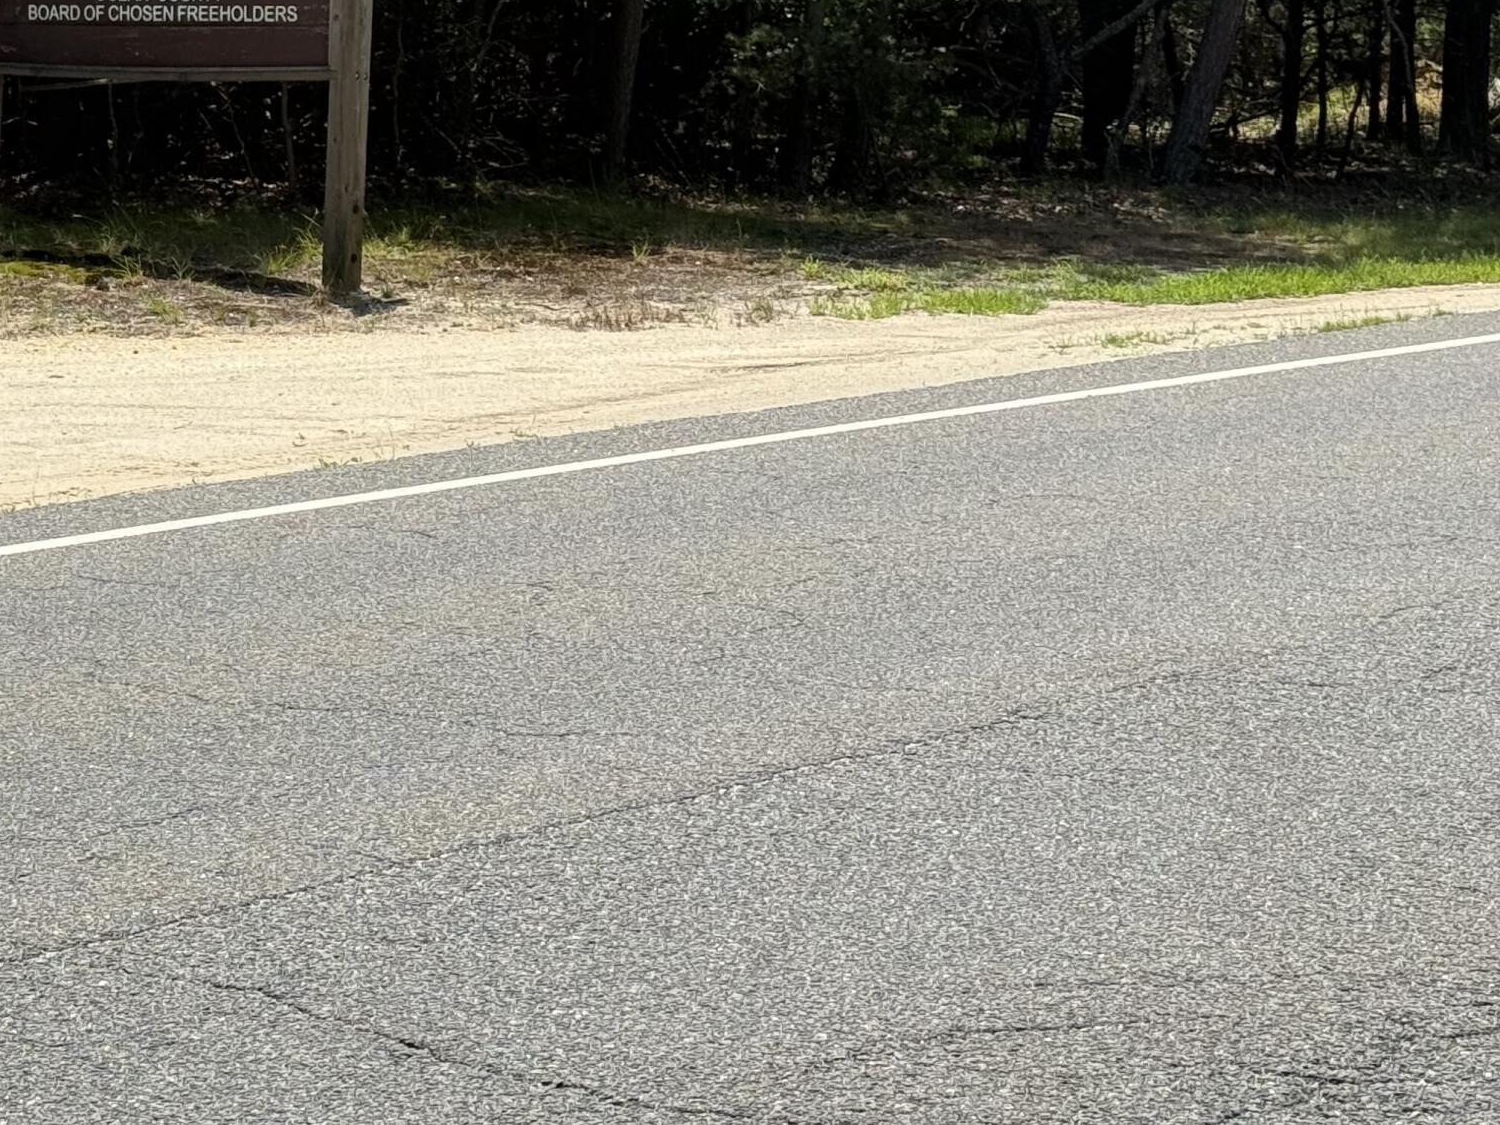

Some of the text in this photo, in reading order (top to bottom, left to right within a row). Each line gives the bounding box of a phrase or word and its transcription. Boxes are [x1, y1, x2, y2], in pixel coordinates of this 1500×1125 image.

[28, 4, 298, 23] BOARD OF CHOSEN FREEHOLDERS
